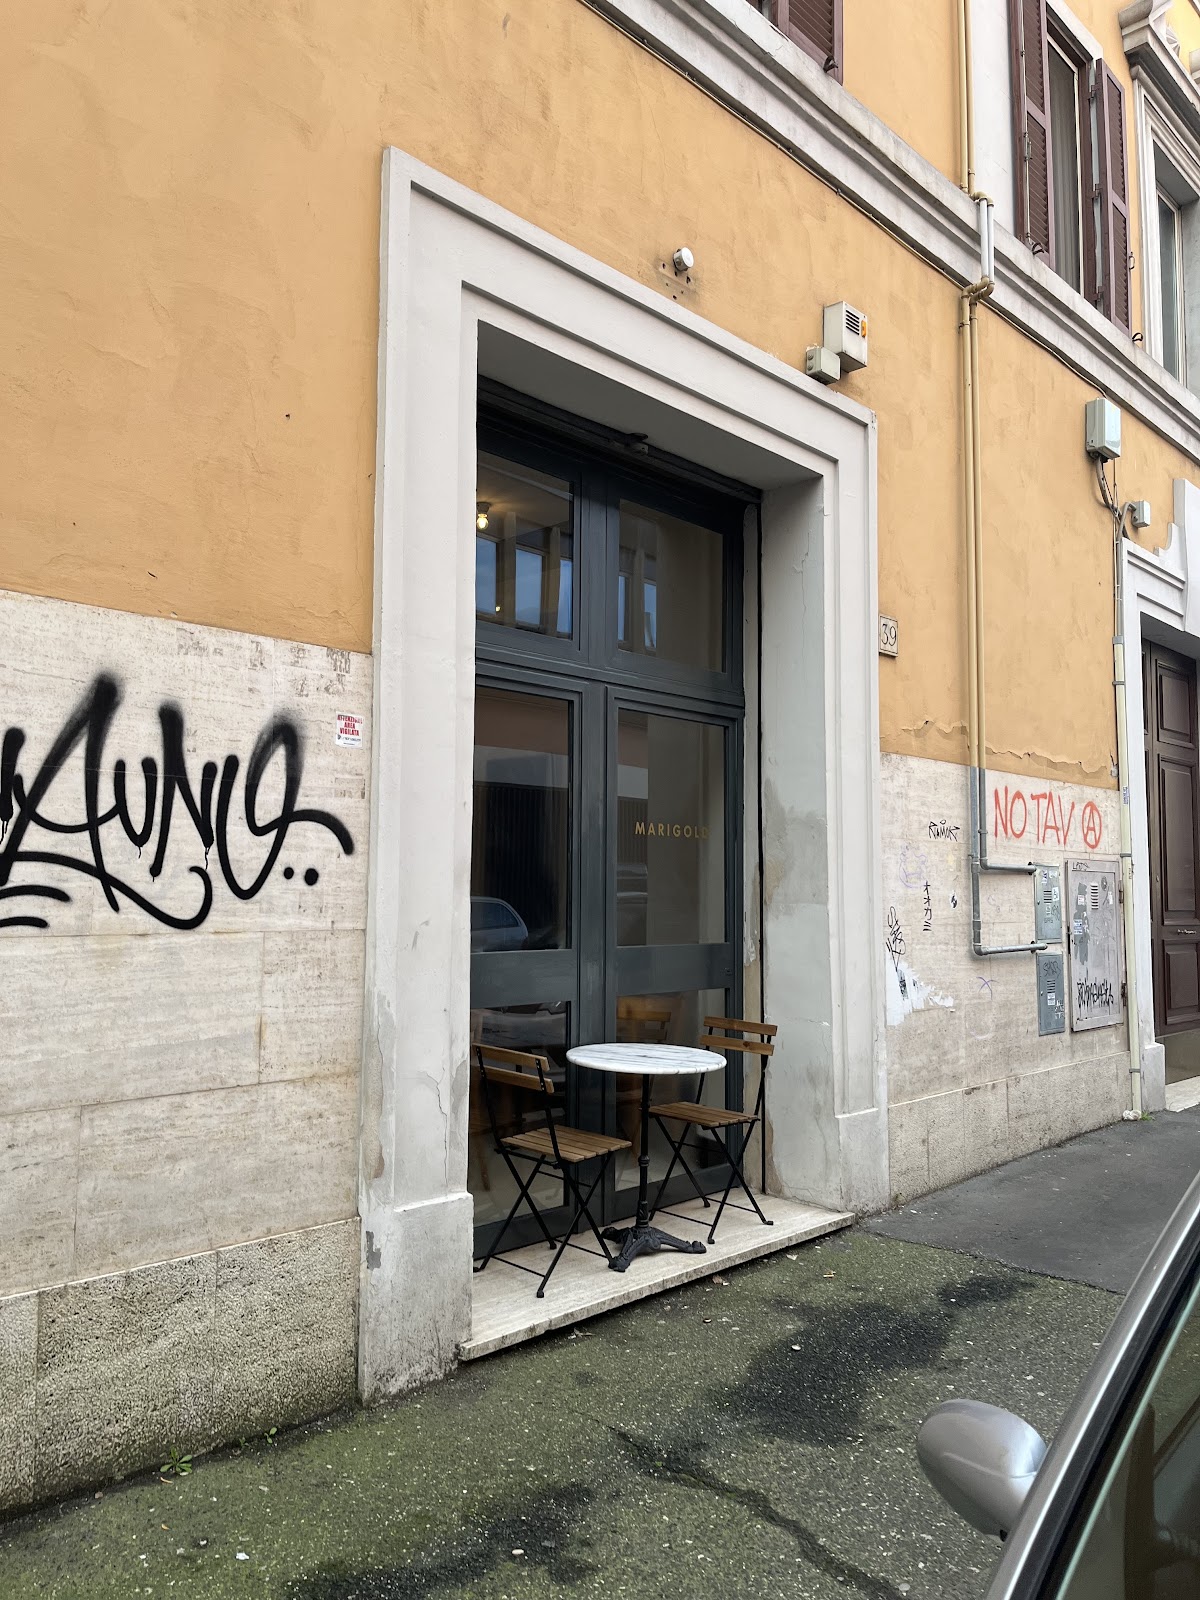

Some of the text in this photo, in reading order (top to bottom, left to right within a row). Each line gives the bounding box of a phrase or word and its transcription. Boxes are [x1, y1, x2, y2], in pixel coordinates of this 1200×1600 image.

[881, 623, 897, 647] 39
[339, 728, 359, 736] VIGILATA
[344, 721, 355, 729] AREA
[994, 786, 1027, 839] NO
[1030, 790, 1075, 846] TAV
[634, 821, 709, 839] MARIGOLD
